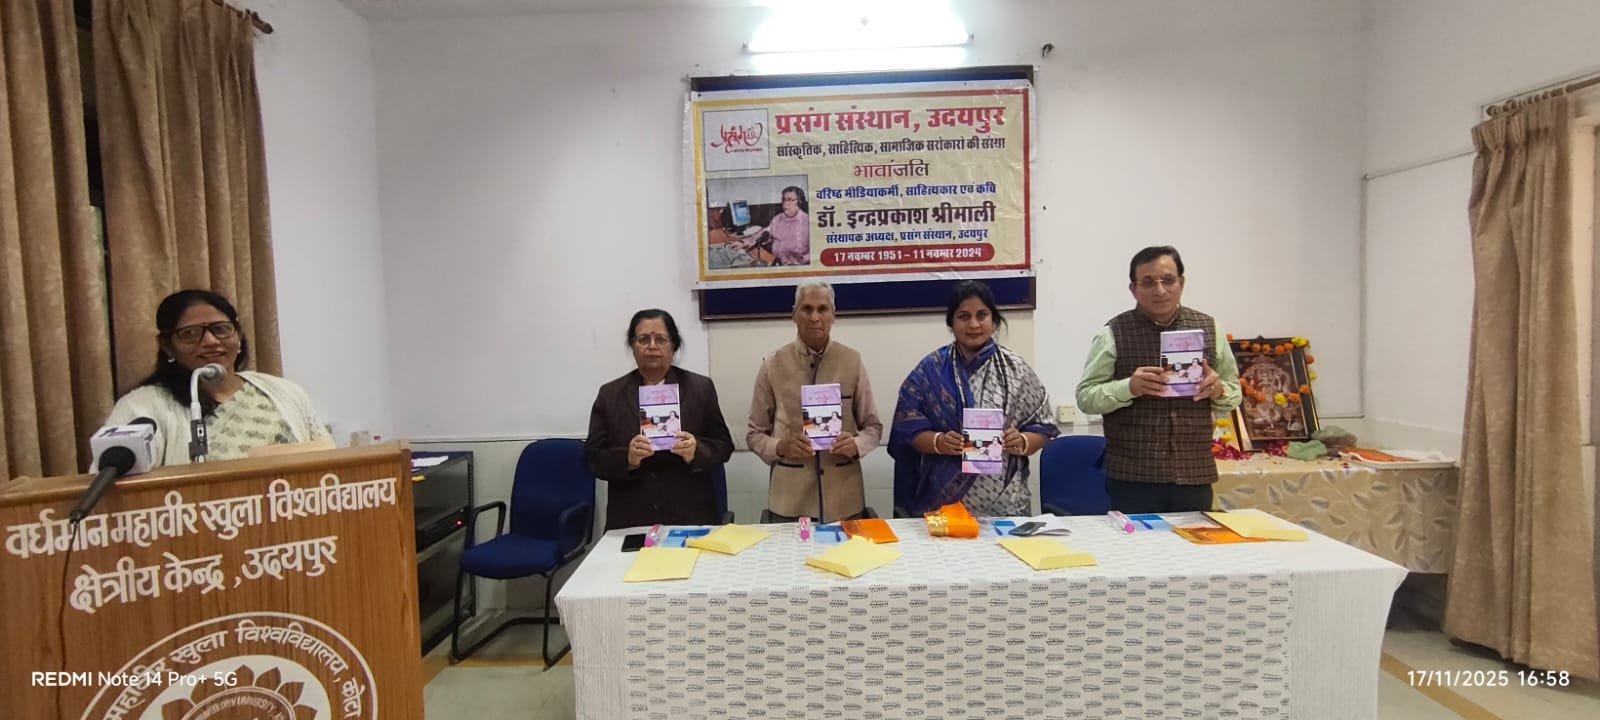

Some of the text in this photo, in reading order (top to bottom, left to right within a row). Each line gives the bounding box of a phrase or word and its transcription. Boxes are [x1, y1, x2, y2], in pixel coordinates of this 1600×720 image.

[775, 105, 1006, 135] प्रसंग संस्थान, उदयपुर
[776, 142, 826, 160] सांस्कृतिक,
[828, 140, 877, 155] साहित्यिक,
[879, 138, 925, 153] सामाजिक
[966, 136, 980, 150] की
[854, 158, 930, 178] भावांजलि
[816, 181, 996, 200] वरिष्ठ मीडियाकर्मी, साहित्यकार एवं कवि
[816, 200, 997, 229] डॉ. इन्द्रप्रकाश श्रीमाली
[824, 227, 988, 244] संस्थापक अध्यक्ष, प्रसंग संस्थान, उदयपुर
[833, 251, 846, 262] 17
[877, 249, 902, 261] 1951
[912, 249, 925, 260] 11
[955, 247, 982, 259] 2024
[5, 473, 397, 559] वर्धमान महावीर खुला विश्वविद्यालय
[69, 555, 161, 614] क्षेत्रीय
[162, 551, 226, 595] केन्द्र
[169, 630, 229, 665] खुला
[234, 619, 349, 683] विश्वविद्यालय,
